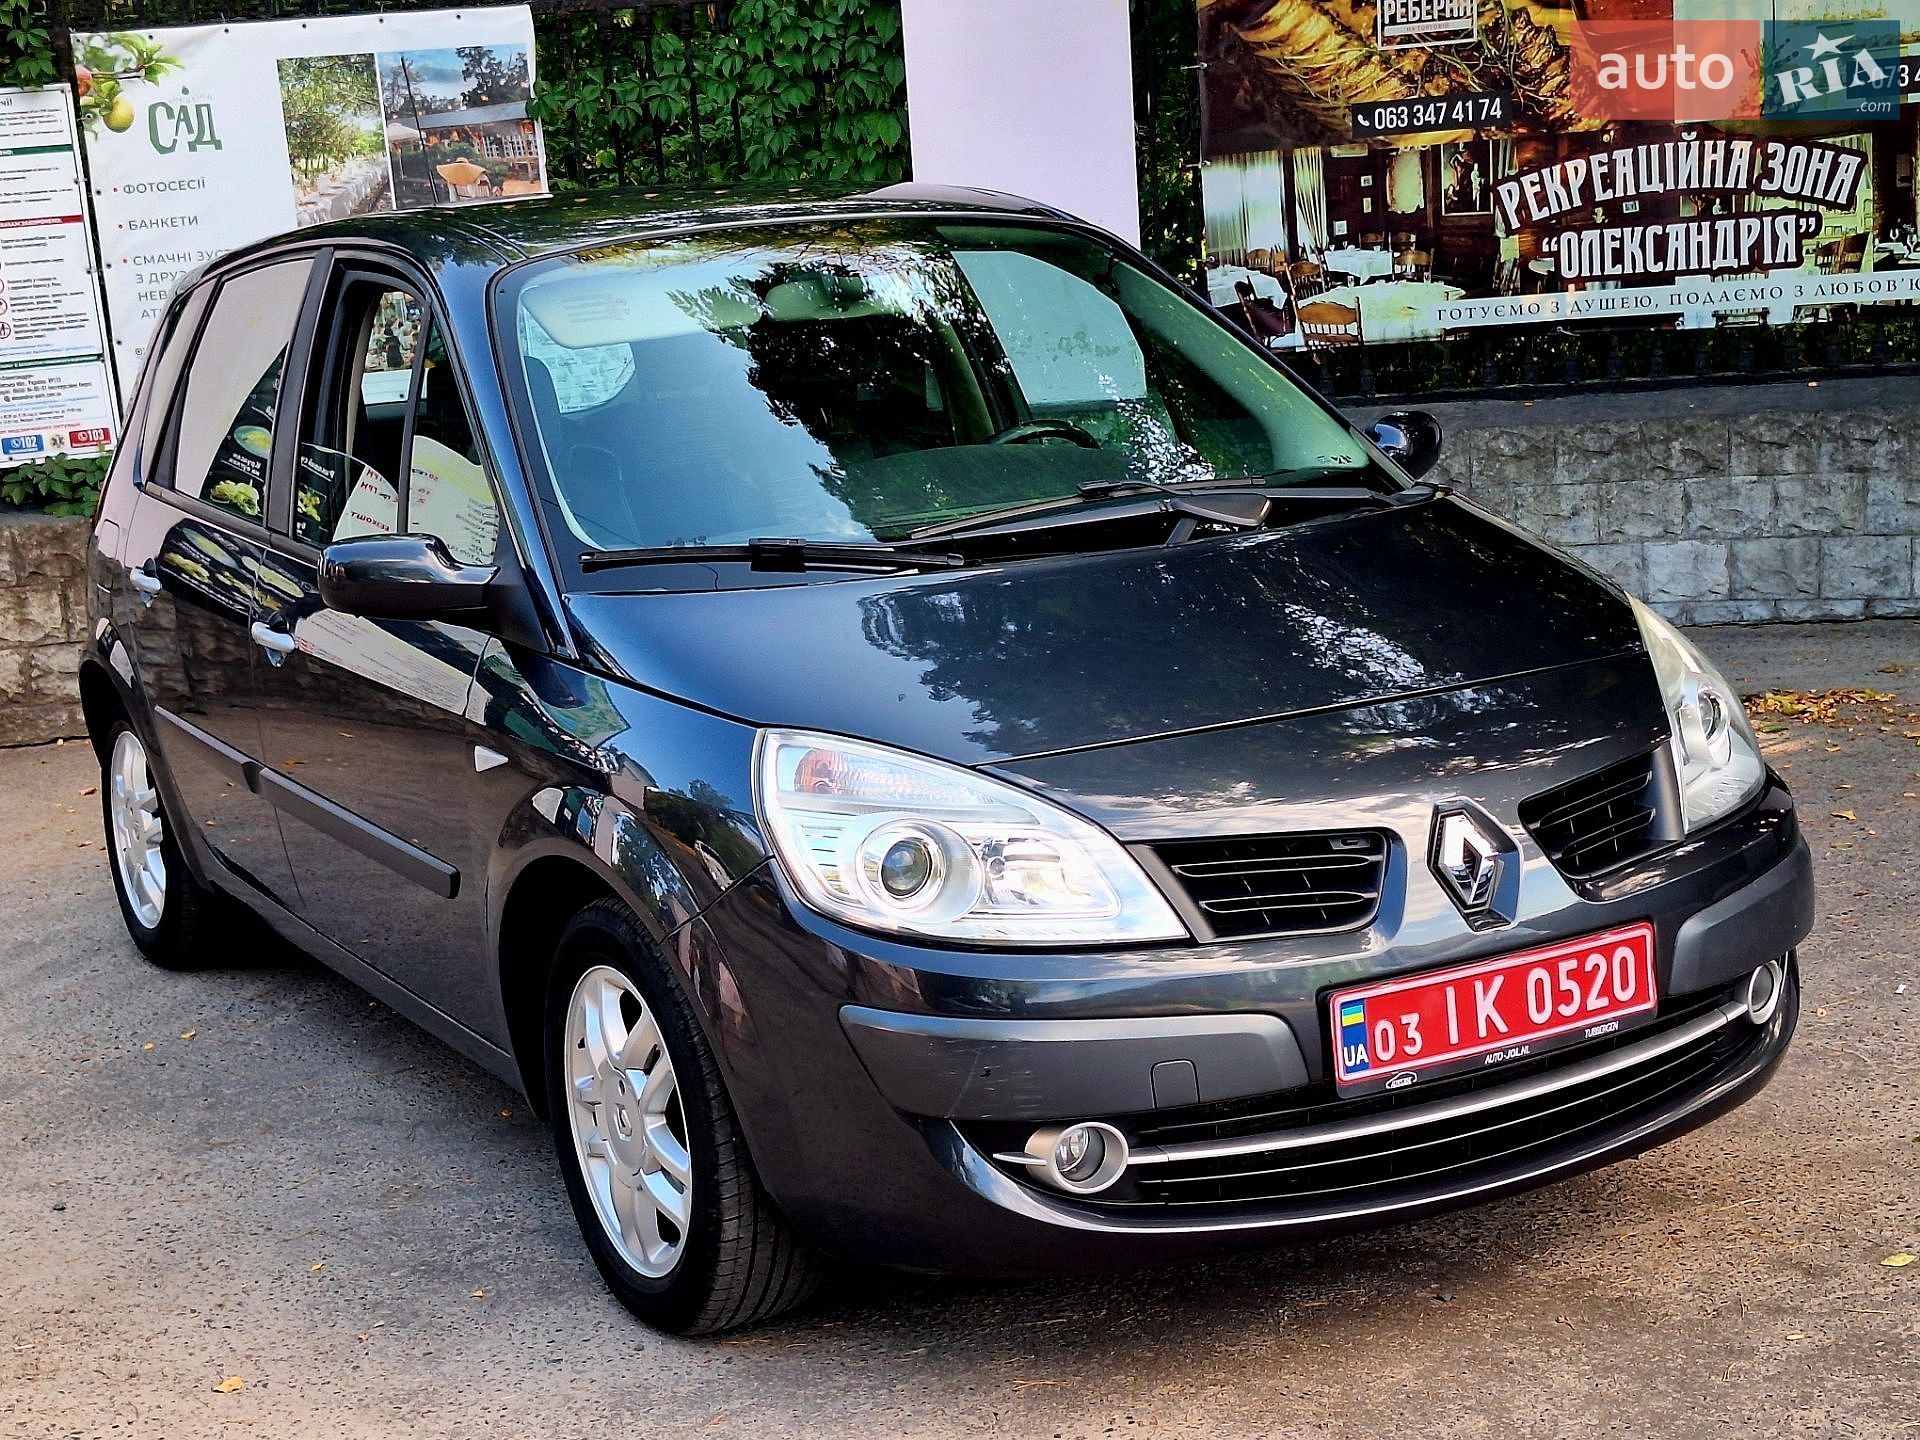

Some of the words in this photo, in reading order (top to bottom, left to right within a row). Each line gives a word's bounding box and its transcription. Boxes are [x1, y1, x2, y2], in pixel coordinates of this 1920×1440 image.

[1374, 106, 1408, 130] 063
[1413, 102, 1448, 126] 347
[1452, 100, 1473, 122] 41
[1478, 97, 1503, 121] 74
[148, 101, 223, 155] САД
[123, 176, 206, 194] ФОТОСЕСІЇ
[1496, 130, 1753, 230] РЕКРЕАЦІЙНА
[1760, 144, 1863, 205] ЗОНА
[128, 215, 199, 231] БАНКЕТИ
[133, 252, 192, 266] СМАЧНІ
[136, 274, 144, 284] З
[1437, 302, 1541, 321] ГОТУЄМО
[1550, 301, 1560, 313] З
[1570, 295, 1659, 315] ДУШЕЮ,
[1669, 286, 1784, 306] ПОДАЄМО
[1794, 284, 1804, 297] З
[22, 436, 37, 449] 102
[88, 429, 104, 441] 103
[1344, 1046, 1369, 1068] UA
[1374, 1012, 1423, 1062] 03
[1446, 974, 1509, 1045] IK
[1526, 946, 1636, 1025] 0520
